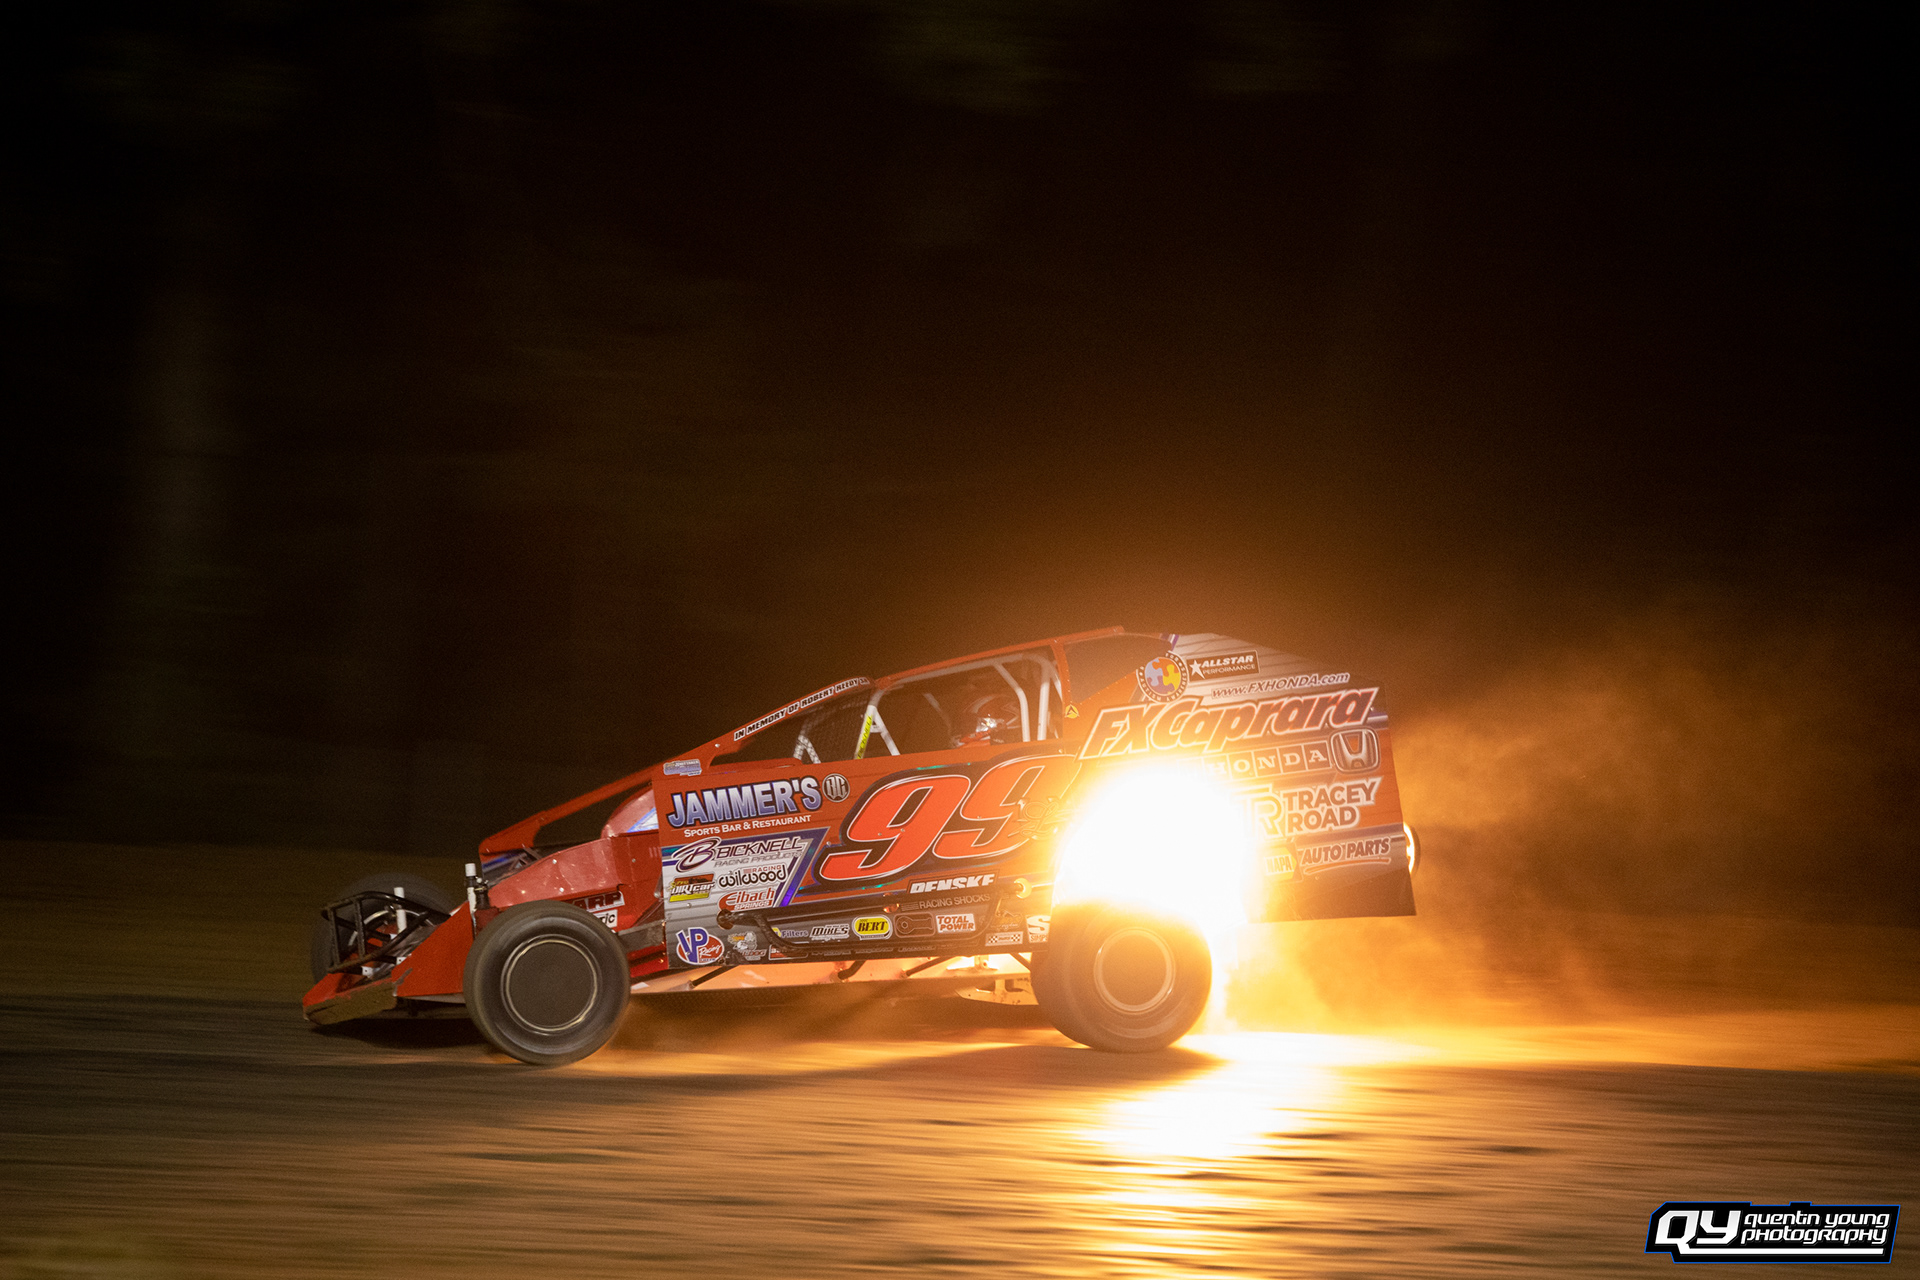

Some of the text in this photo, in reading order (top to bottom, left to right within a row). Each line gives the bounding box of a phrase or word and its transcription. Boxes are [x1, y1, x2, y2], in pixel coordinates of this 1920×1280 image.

[1201, 655, 1254, 668] ALLSTAR
[1202, 664, 1256, 675] PERFORMANCE
[1212, 672, 1350, 698] www.FXHONDA.com
[734, 729, 745, 740] IN
[747, 709, 787, 734] MEMORY
[788, 702, 800, 713] OF
[801, 687, 834, 708] ROBERT
[1207, 750, 1328, 777] HONDA
[667, 776, 822, 828] JAMMER'S
[1282, 781, 1378, 812] TRACEY
[743, 821, 751, 830] &
[1287, 807, 1358, 834] ROAD
[716, 837, 804, 860] BICKNELL
[1301, 837, 1391, 866] AUTO PARTS
[714, 851, 803, 868] RACING PRODUCTS
[1266, 856, 1293, 873] NAPA
[719, 864, 787, 888] wilwood
[752, 864, 782, 873] RACING
[720, 888, 775, 907] Eibach
[733, 900, 771, 911] SPRINGS
[919, 893, 991, 910] RACING SHOCKS
[857, 921, 888, 932] BERT
[938, 915, 970, 924] TOTAL
[939, 923, 975, 931] POWER
[676, 927, 709, 964] VP
[698, 944, 723, 959] Racing
